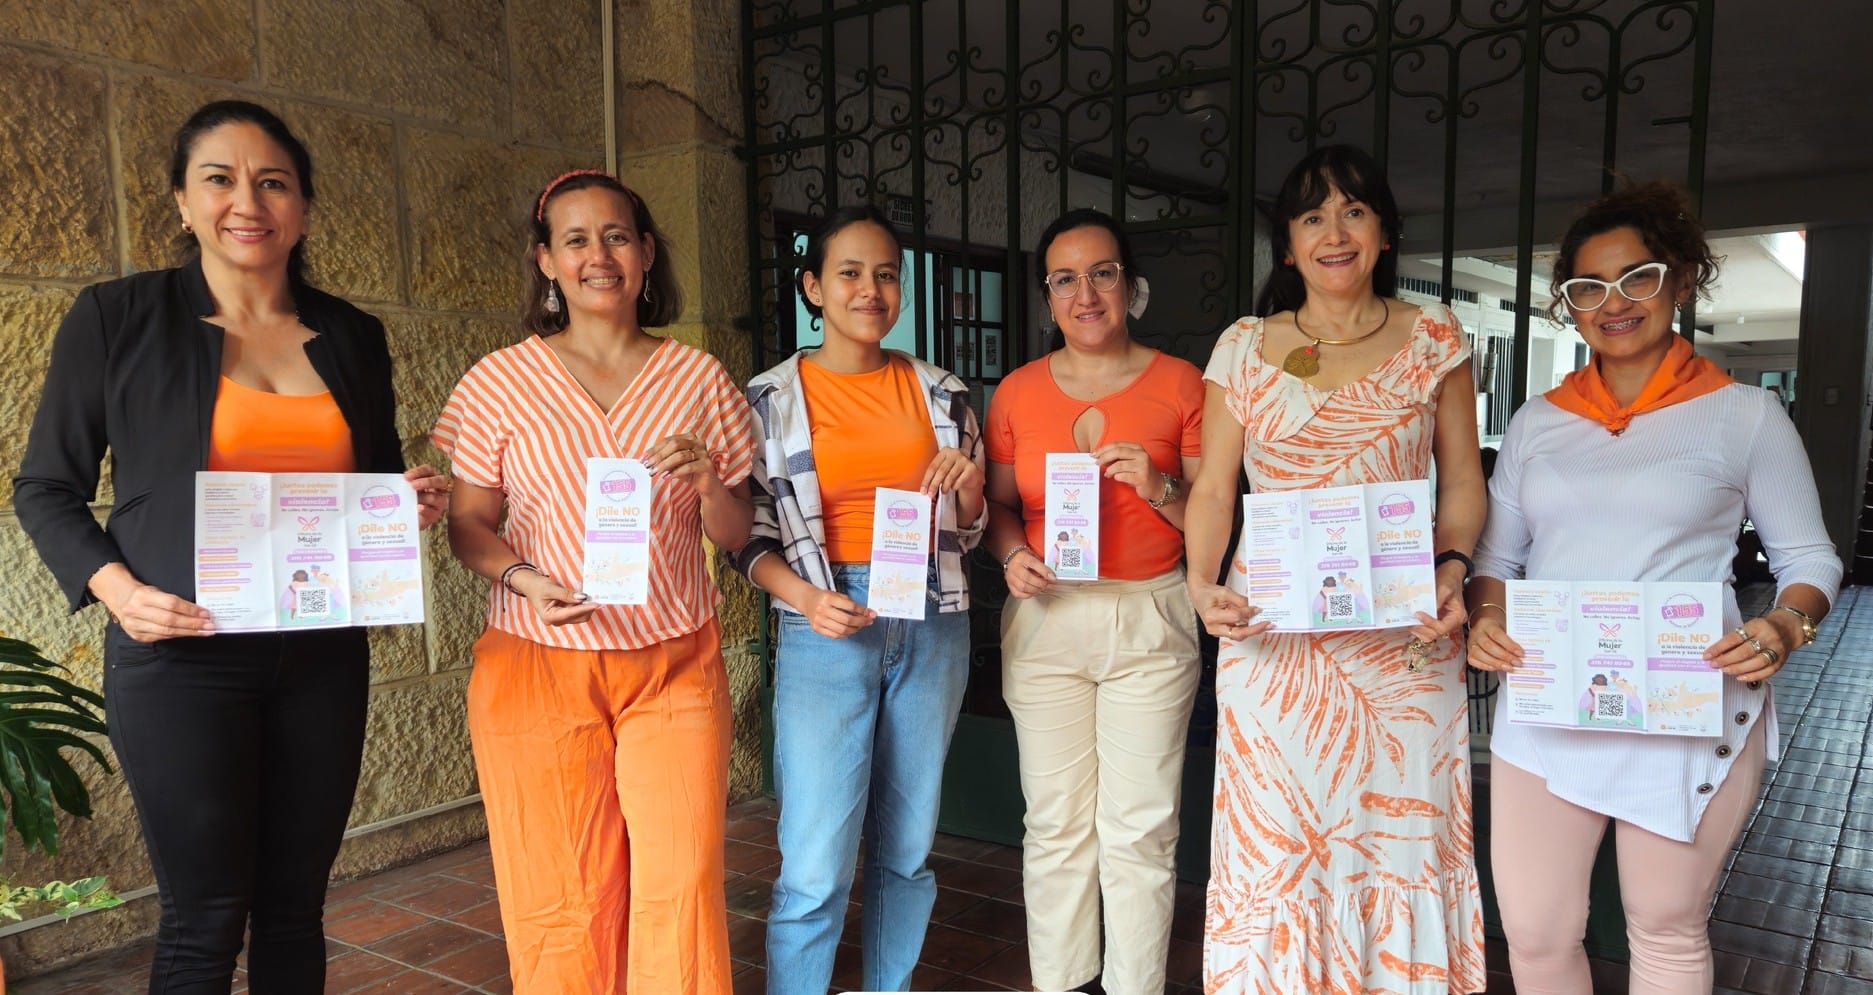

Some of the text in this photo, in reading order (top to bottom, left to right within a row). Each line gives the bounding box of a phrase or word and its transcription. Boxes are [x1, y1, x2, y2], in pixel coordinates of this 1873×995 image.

[622, 506, 640, 516] NO
[388, 523, 407, 533] NO
[905, 532, 921, 541] NO
[1403, 529, 1421, 539] NO
[297, 536, 321, 544] Mujer
[1657, 633, 1711, 644] ¡Dile NO
